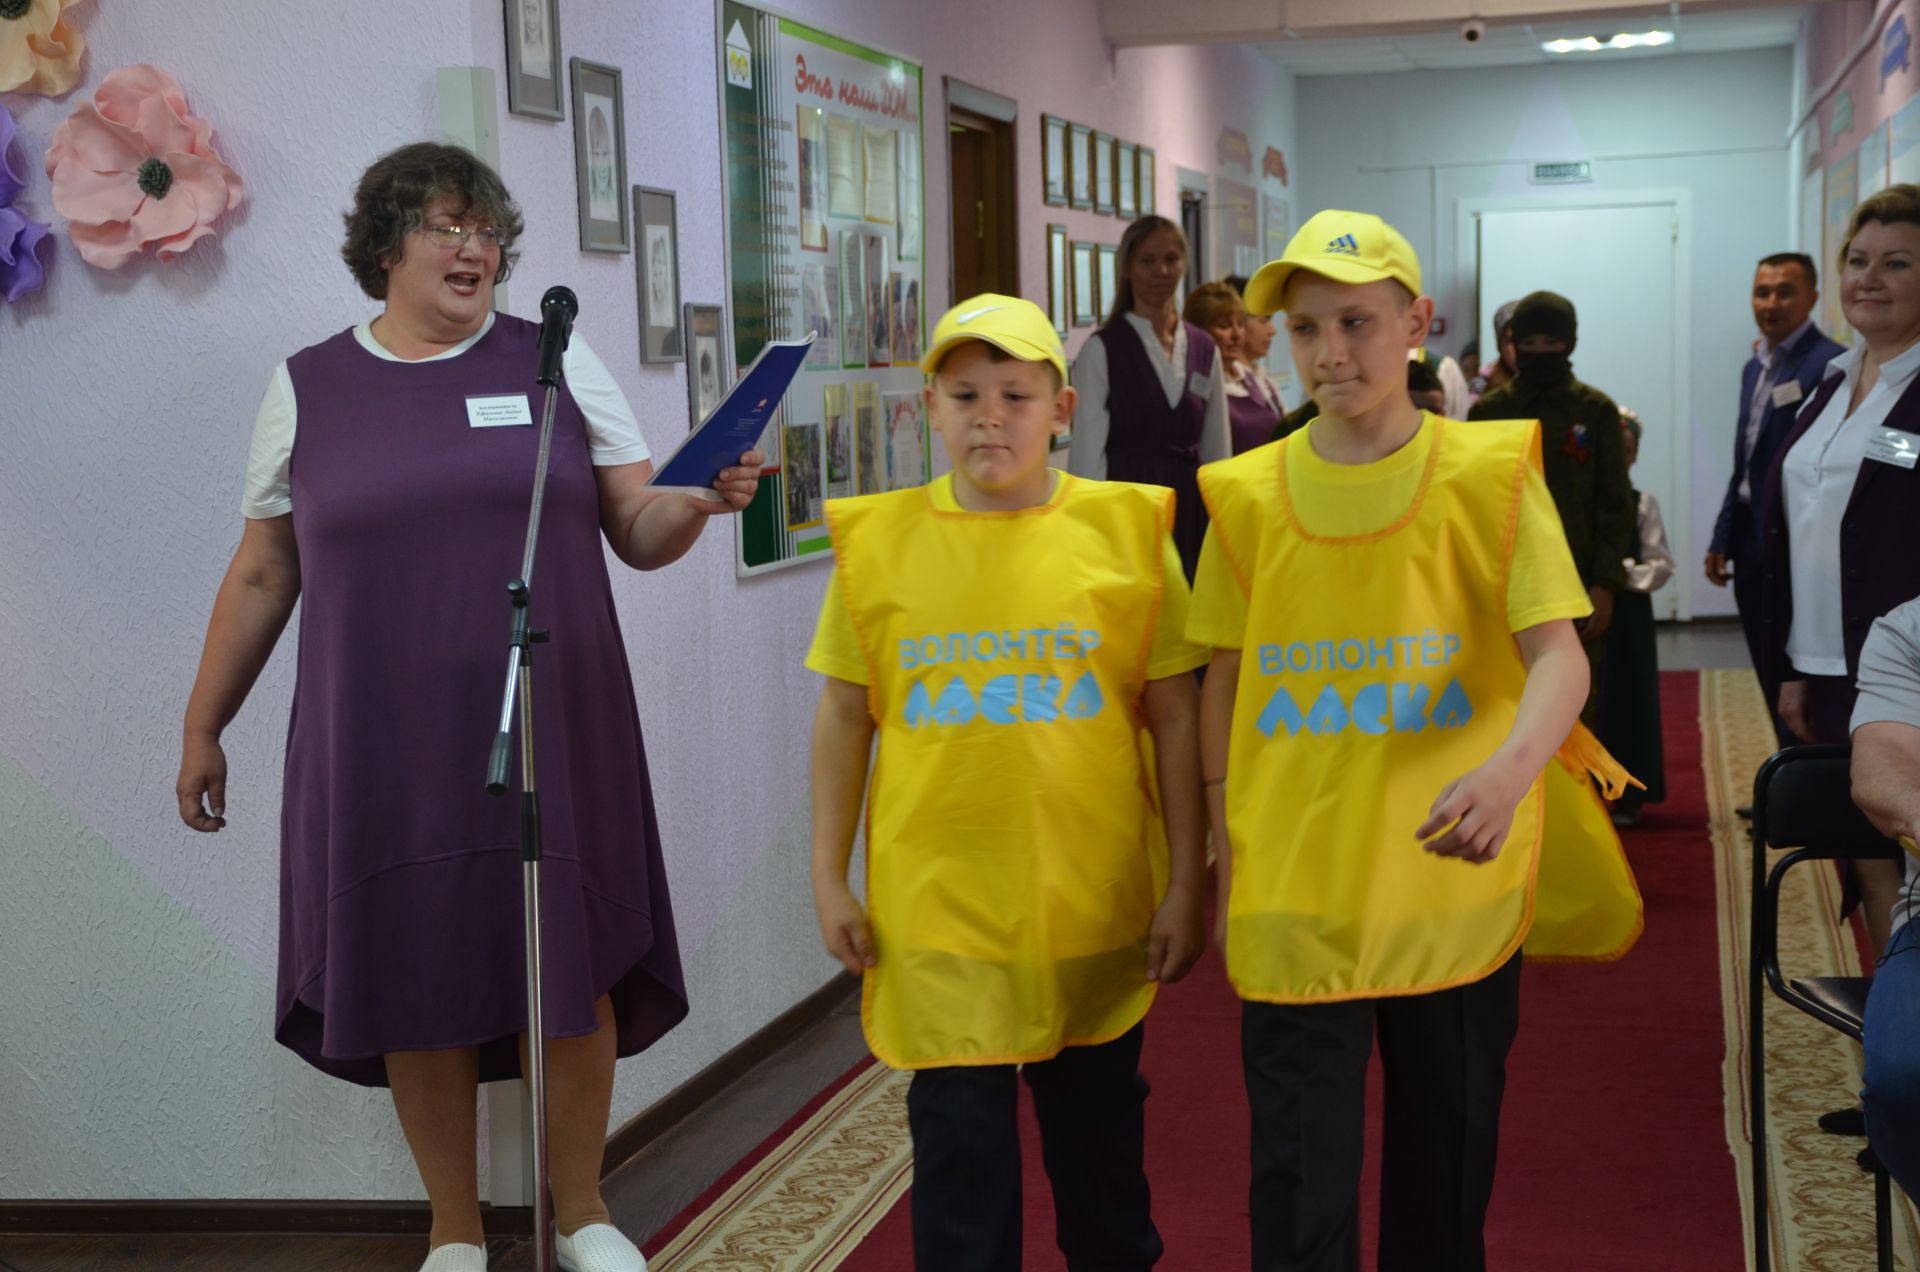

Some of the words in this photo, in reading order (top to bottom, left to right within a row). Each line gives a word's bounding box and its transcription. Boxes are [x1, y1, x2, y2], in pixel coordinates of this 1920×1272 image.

[795, 53, 834, 99] Это
[898, 621, 1101, 669] ВОЛОНТЁР
[1258, 628, 1461, 675] ВОЛОНТЁР
[903, 671, 1104, 729] ЛАСКА
[1255, 676, 1473, 740] ЛАСКА
